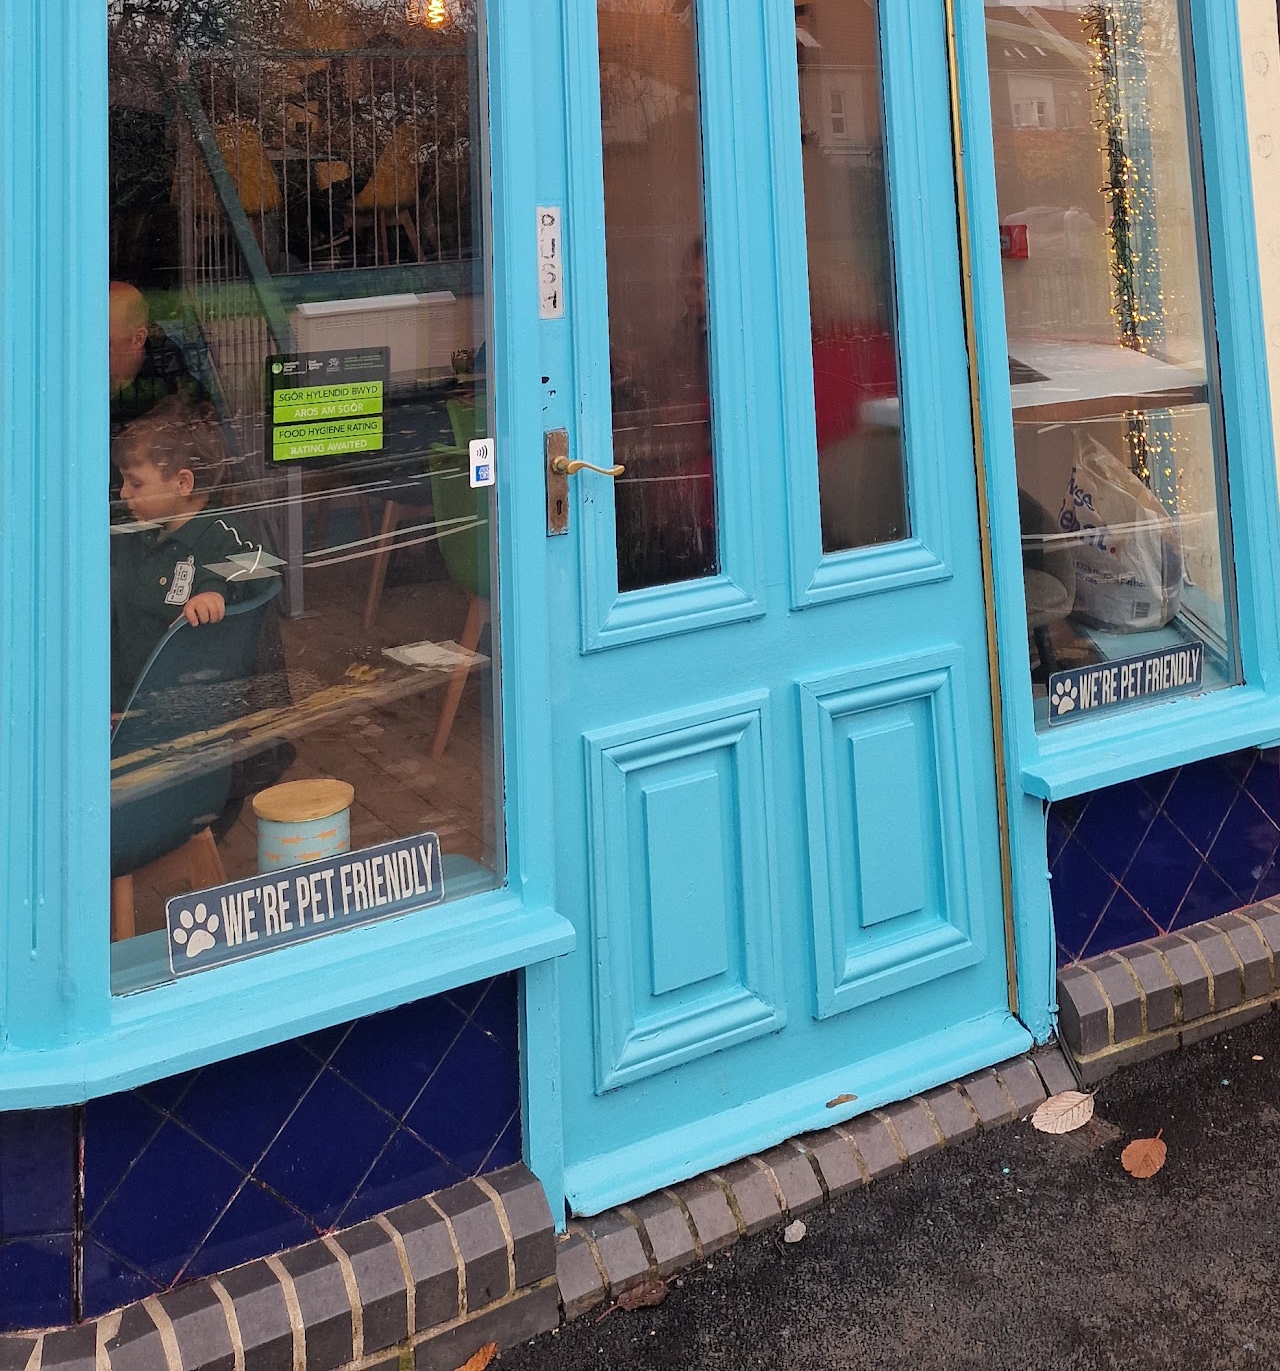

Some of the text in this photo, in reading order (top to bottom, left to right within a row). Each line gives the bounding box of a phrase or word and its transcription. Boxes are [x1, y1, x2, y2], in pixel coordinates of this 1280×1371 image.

[278, 385, 378, 402] SGÔR HYLENDID BWYD
[294, 402, 363, 418] AROS AM SGÔR
[279, 421, 378, 439] FOOD HYGIENE RATING
[290, 439, 368, 456] RATING AWAITED
[1079, 648, 1200, 710] WE'RE PET FRIENDLY
[220, 842, 434, 947] WE'RE PET FRIENDLY
